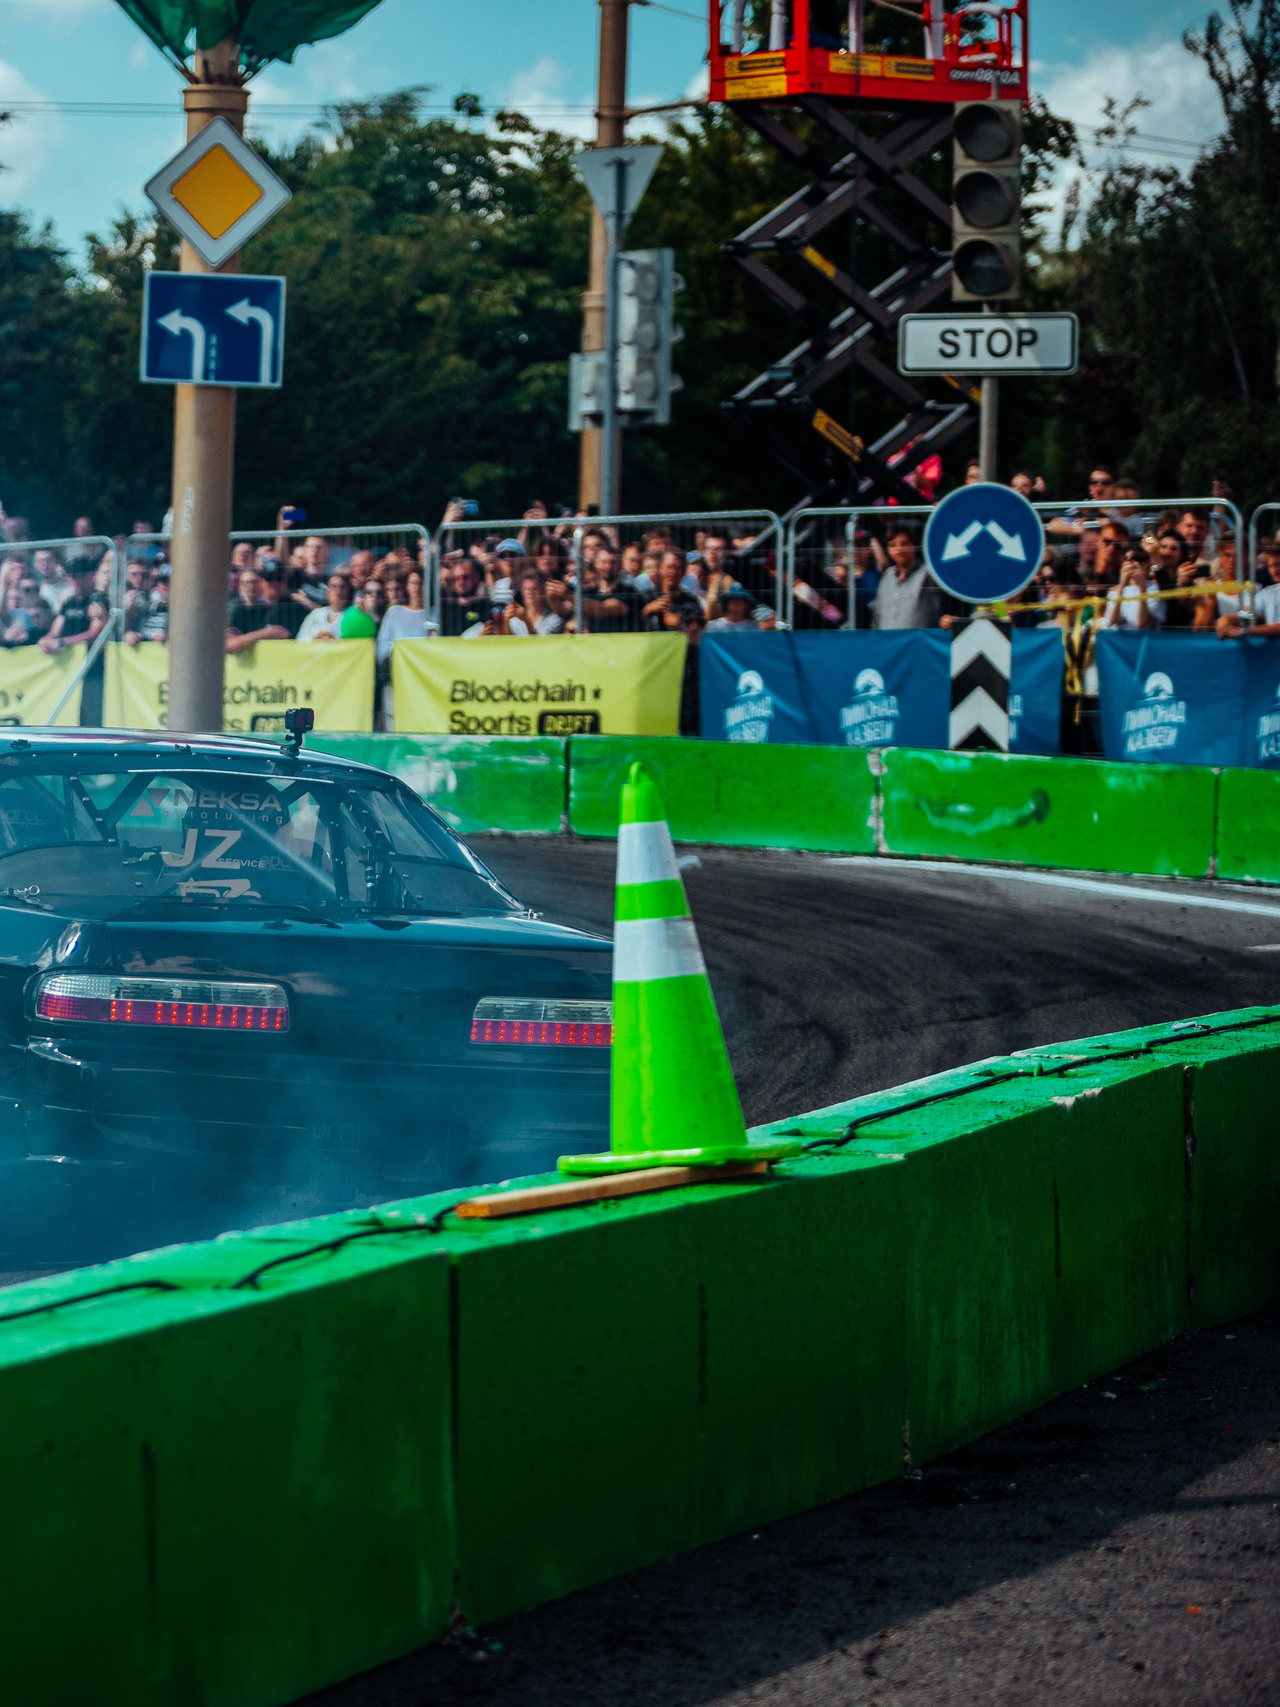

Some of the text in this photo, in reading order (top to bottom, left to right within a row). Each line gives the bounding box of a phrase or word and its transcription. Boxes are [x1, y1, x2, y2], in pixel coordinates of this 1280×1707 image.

[938, 327, 1039, 359] STOP
[158, 679, 297, 704] Bchain
[450, 678, 587, 704] Blockchain
[173, 788, 283, 812] NEKSA
[161, 808, 284, 825] autotuning
[161, 827, 243, 870] JZ
[218, 857, 266, 869] SERVICE
